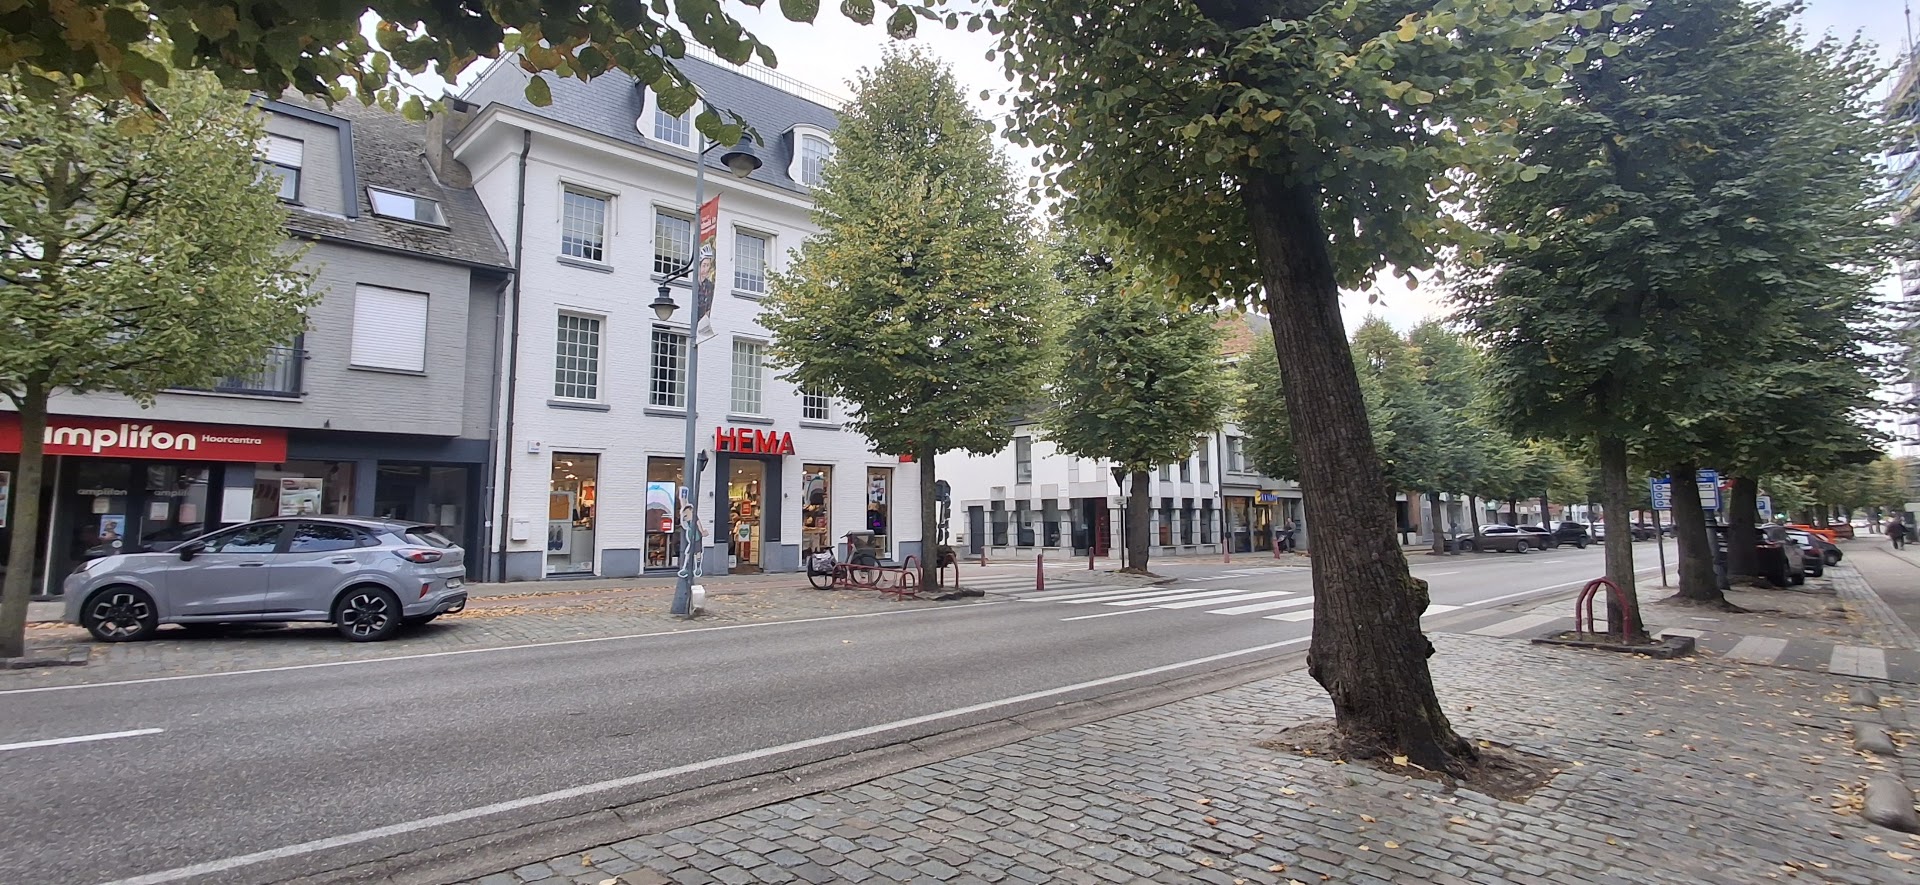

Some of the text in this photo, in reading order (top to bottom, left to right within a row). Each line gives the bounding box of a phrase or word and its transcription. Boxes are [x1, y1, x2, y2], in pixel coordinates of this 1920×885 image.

[201, 434, 262, 445] Hoorcentra
[715, 426, 796, 456] HEMA
[77, 487, 128, 498] amplifon
